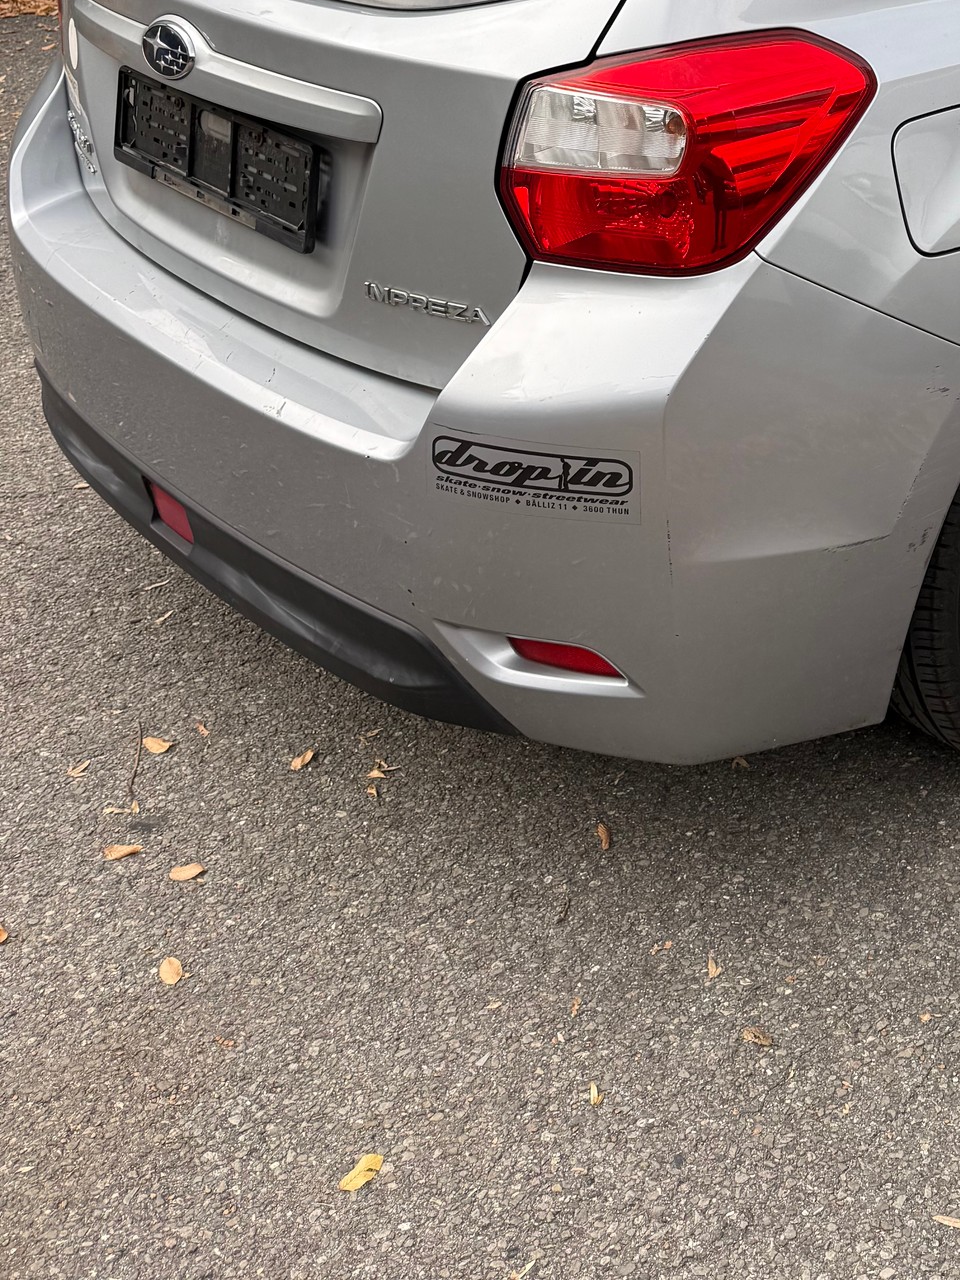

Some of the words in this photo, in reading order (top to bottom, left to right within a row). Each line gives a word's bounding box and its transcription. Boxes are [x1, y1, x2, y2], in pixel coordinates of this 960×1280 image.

[364, 281, 491, 326] IMPREZA
[433, 441, 561, 488] drop
[567, 460, 630, 488] in
[436, 483, 458, 494] SKATE
[467, 490, 511, 503] SNOWSHOP
[583, 505, 604, 513] 3600
[607, 507, 630, 515] THUN
